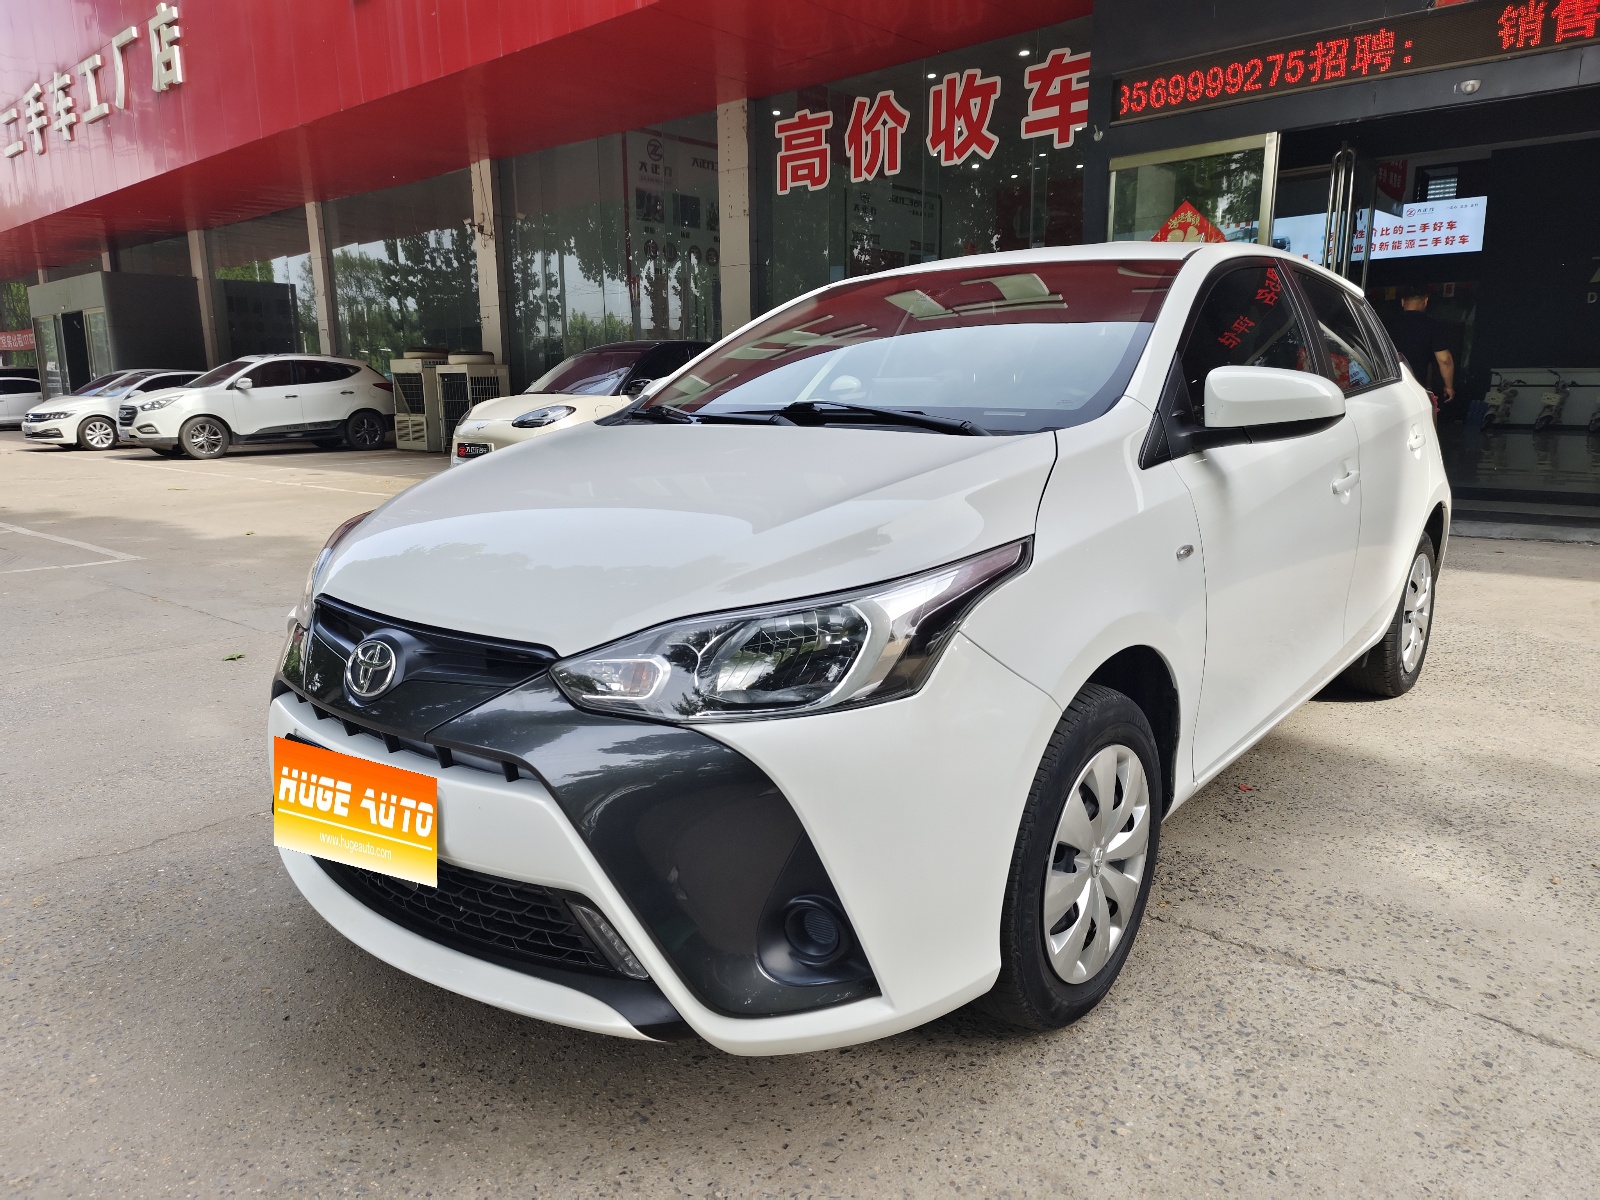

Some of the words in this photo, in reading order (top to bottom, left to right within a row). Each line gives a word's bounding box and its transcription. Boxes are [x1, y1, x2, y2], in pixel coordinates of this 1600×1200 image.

[0, 2, 183, 158] 二手车工厂店
[1498, 0, 1600, 49] 销售
[774, 47, 1091, 195] 高价收车
